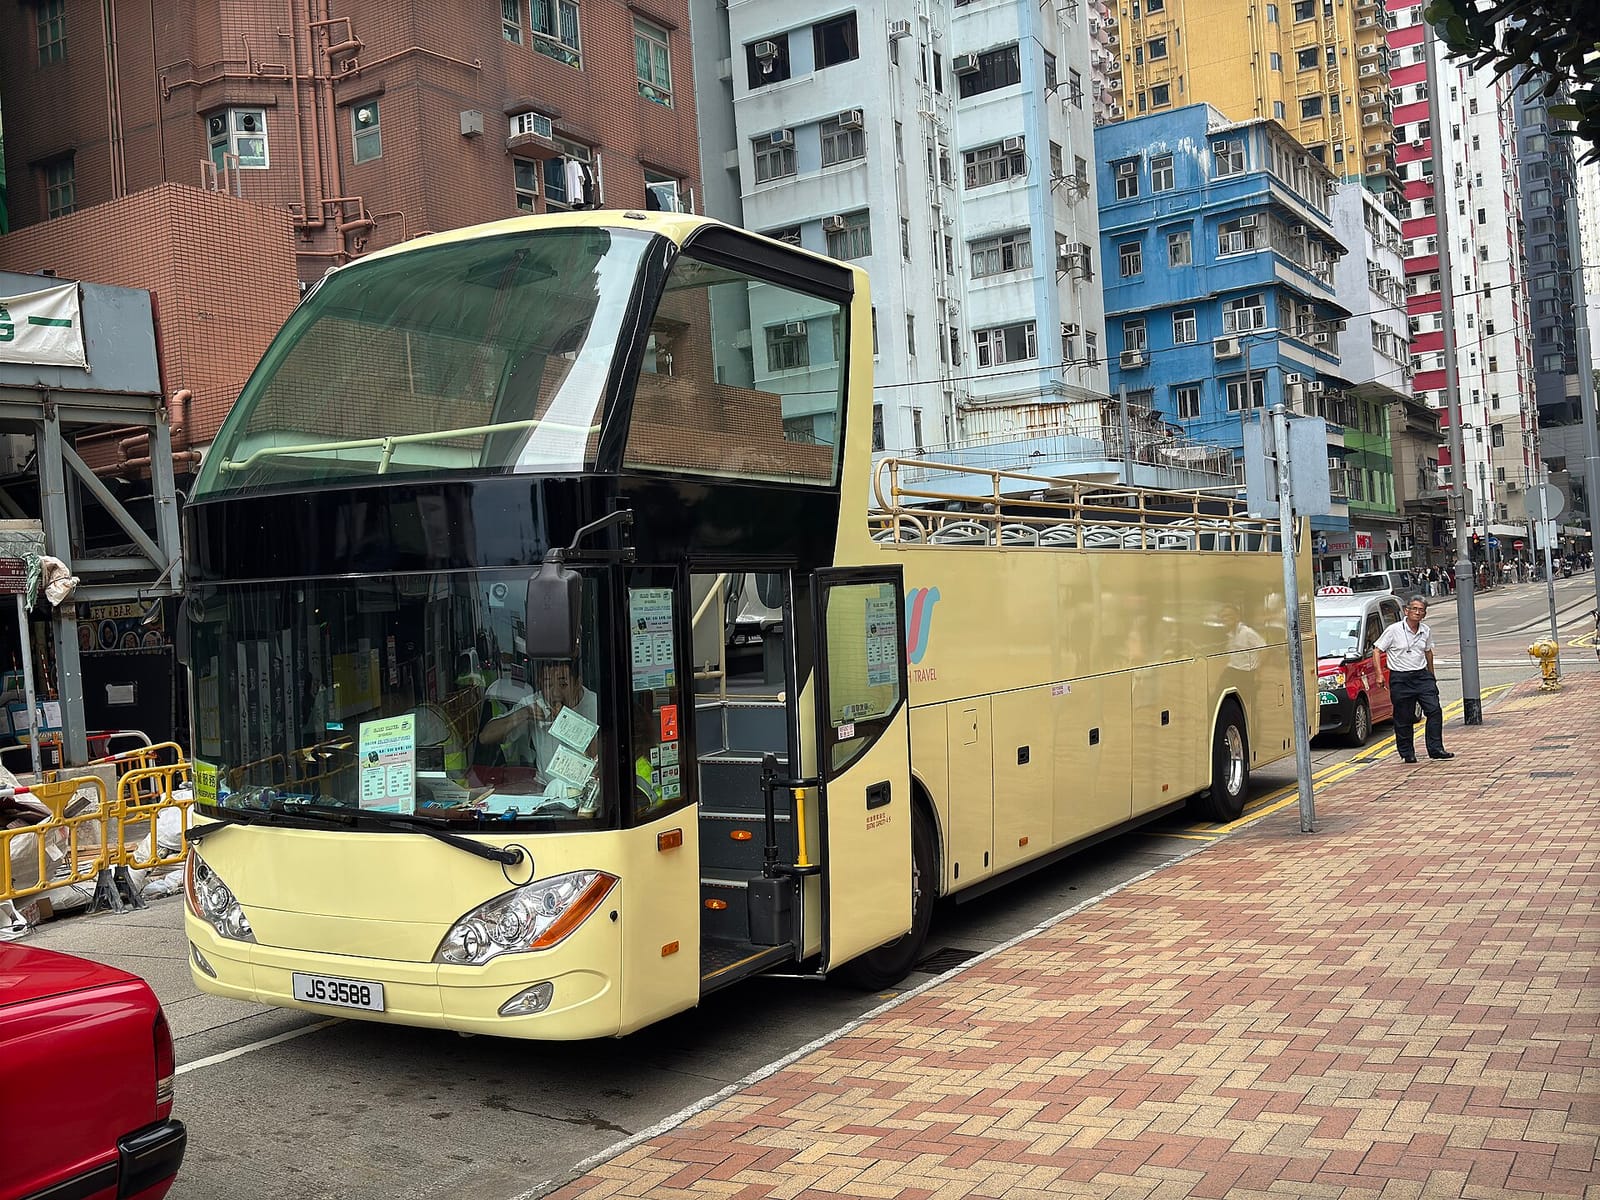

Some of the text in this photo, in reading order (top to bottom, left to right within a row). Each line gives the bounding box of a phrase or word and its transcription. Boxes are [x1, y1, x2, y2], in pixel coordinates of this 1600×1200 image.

[1321, 586, 1349, 594] TAXI
[113, 604, 131, 617] BAR
[913, 667, 937, 683] TRAVEL
